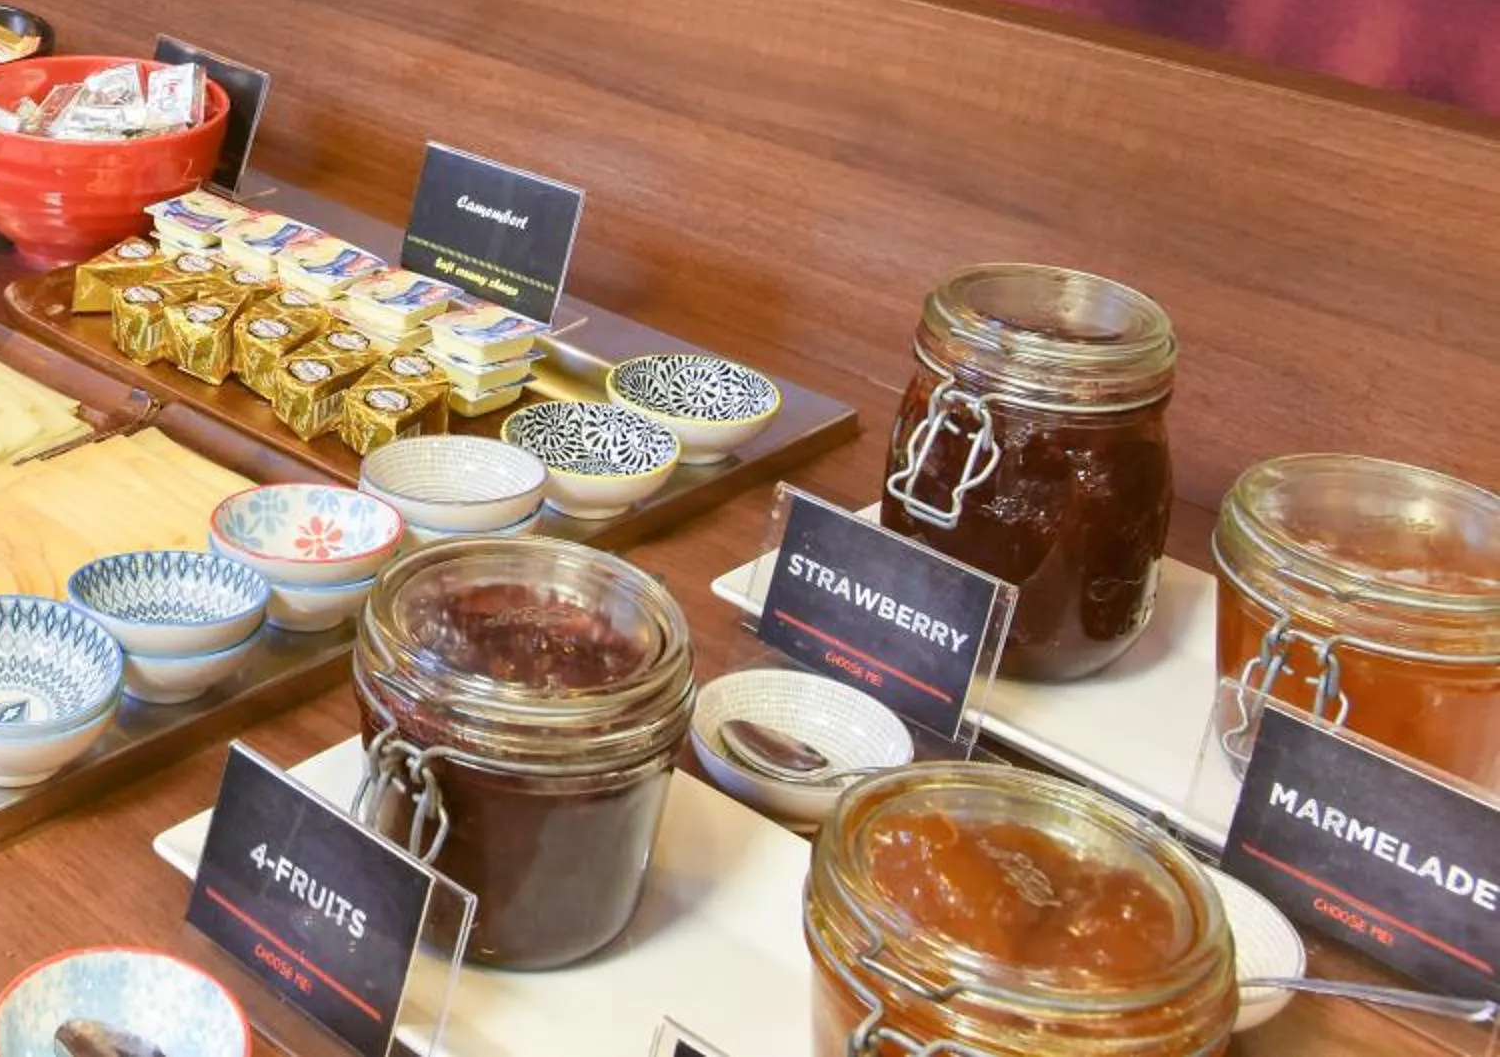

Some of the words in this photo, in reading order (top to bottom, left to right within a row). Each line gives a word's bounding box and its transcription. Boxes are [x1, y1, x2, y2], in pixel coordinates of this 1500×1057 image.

[456, 195, 529, 230] Camembert
[787, 554, 970, 653] STRAWBERRY
[824, 650, 863, 678] CHOOSE
[1269, 782, 1500, 911] MARMELADE
[250, 843, 368, 939] 4-FRUITS
[1314, 897, 1365, 934] CHOOSE
[254, 943, 293, 980] CHOOSE
